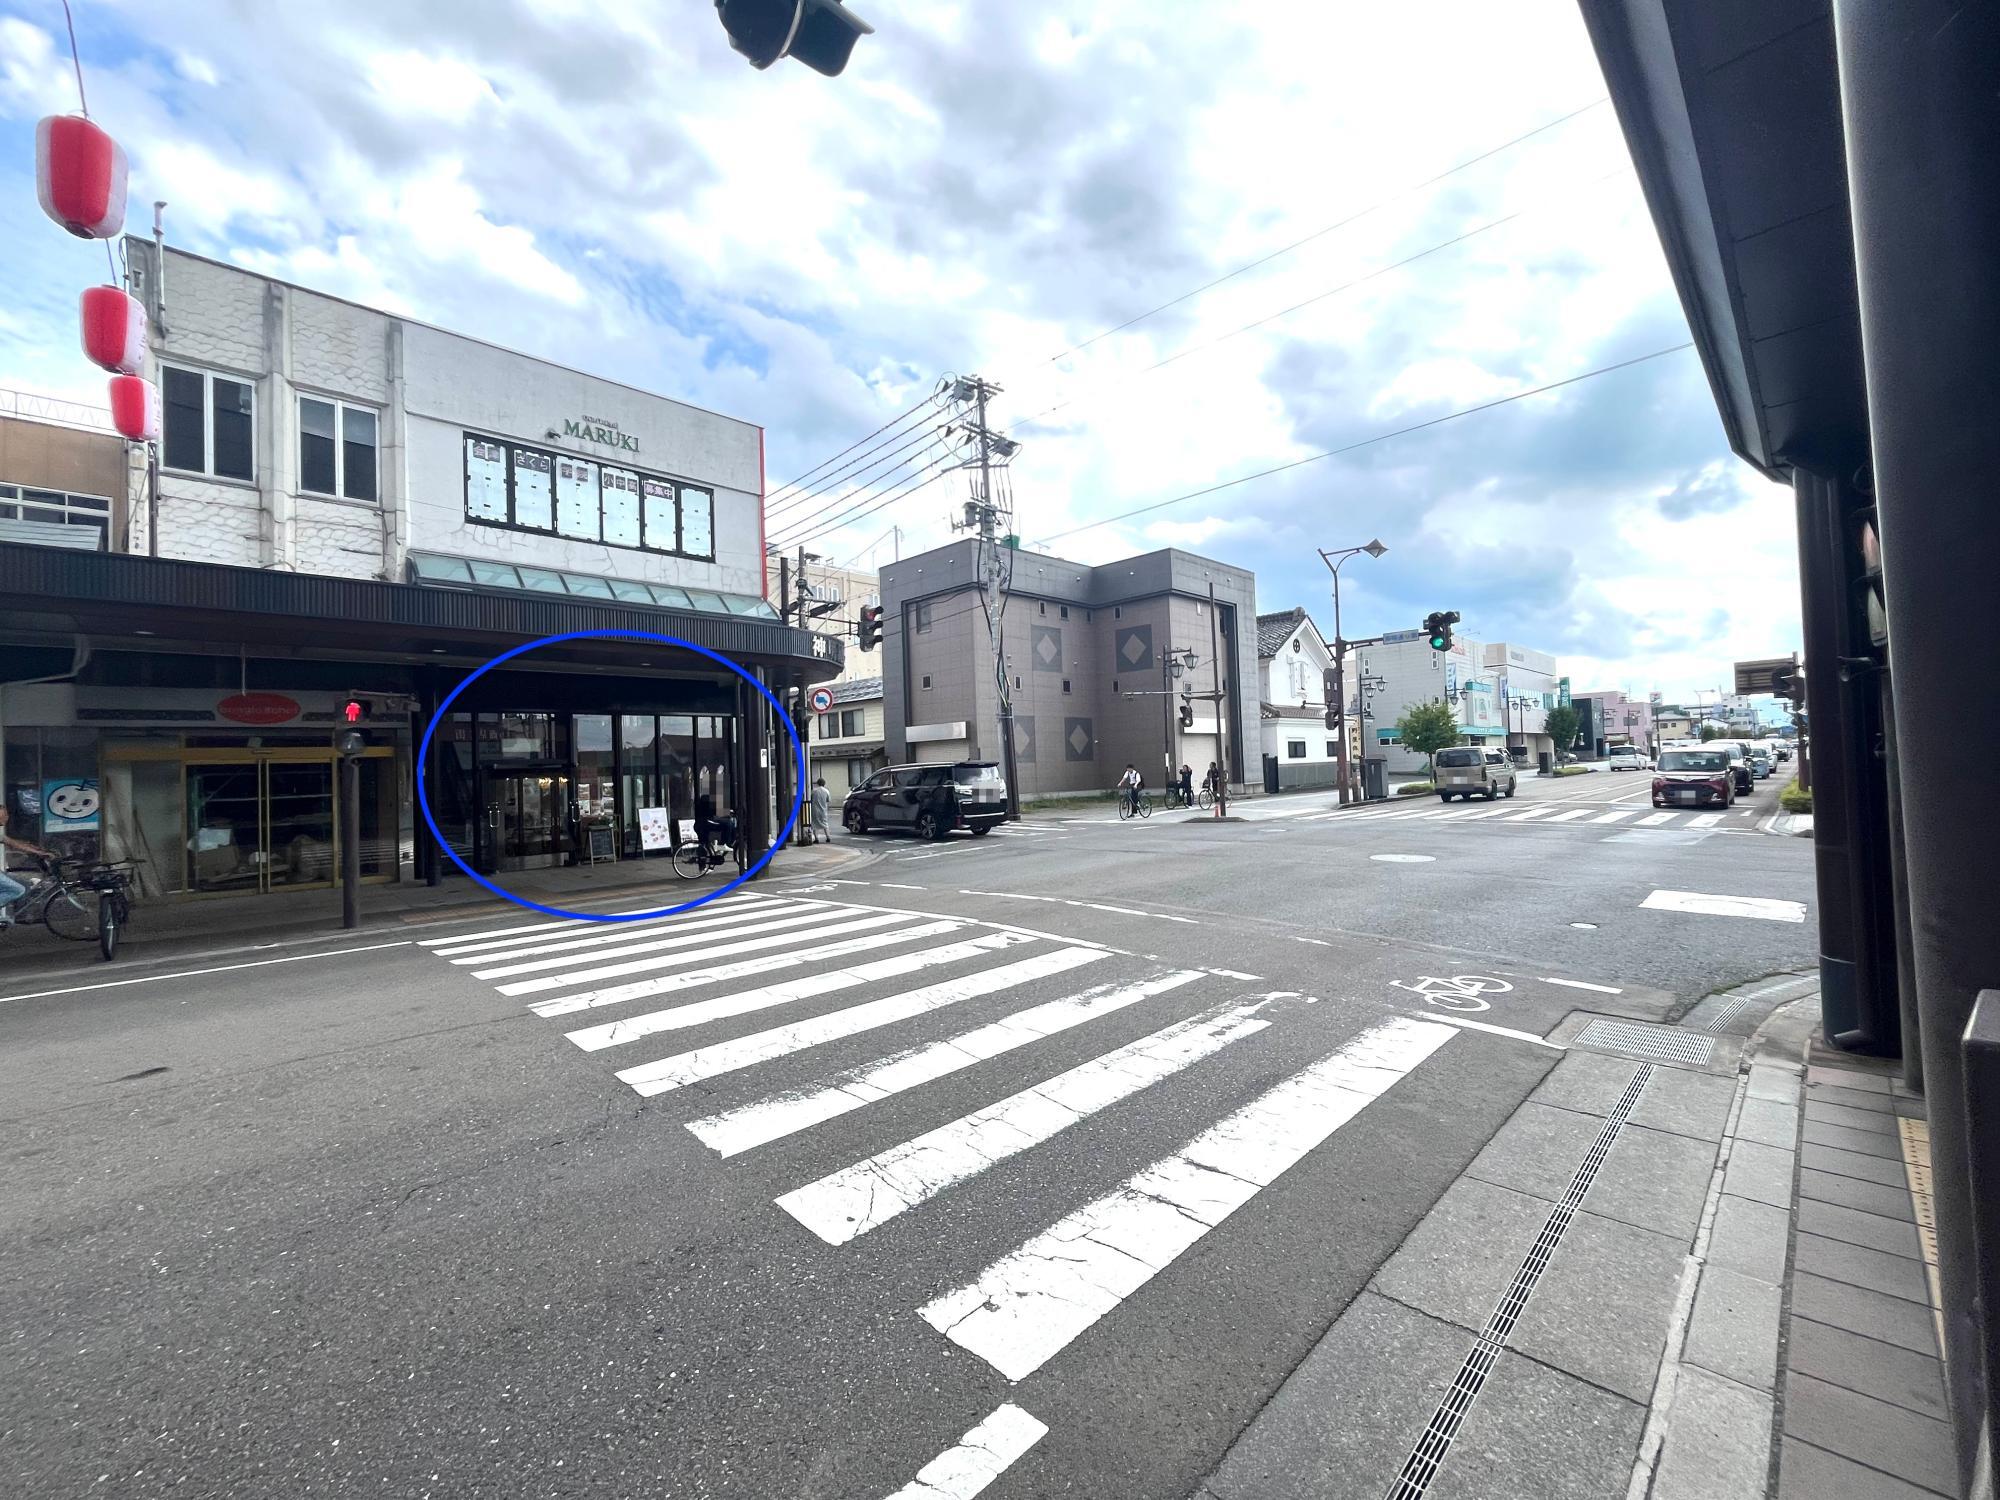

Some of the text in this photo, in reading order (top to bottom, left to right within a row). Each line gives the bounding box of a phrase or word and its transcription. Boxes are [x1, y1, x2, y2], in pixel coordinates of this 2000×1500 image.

[564, 418, 640, 452] MARUKI
[516, 452, 549, 471] さくら
[645, 482, 673, 499] 募集中
